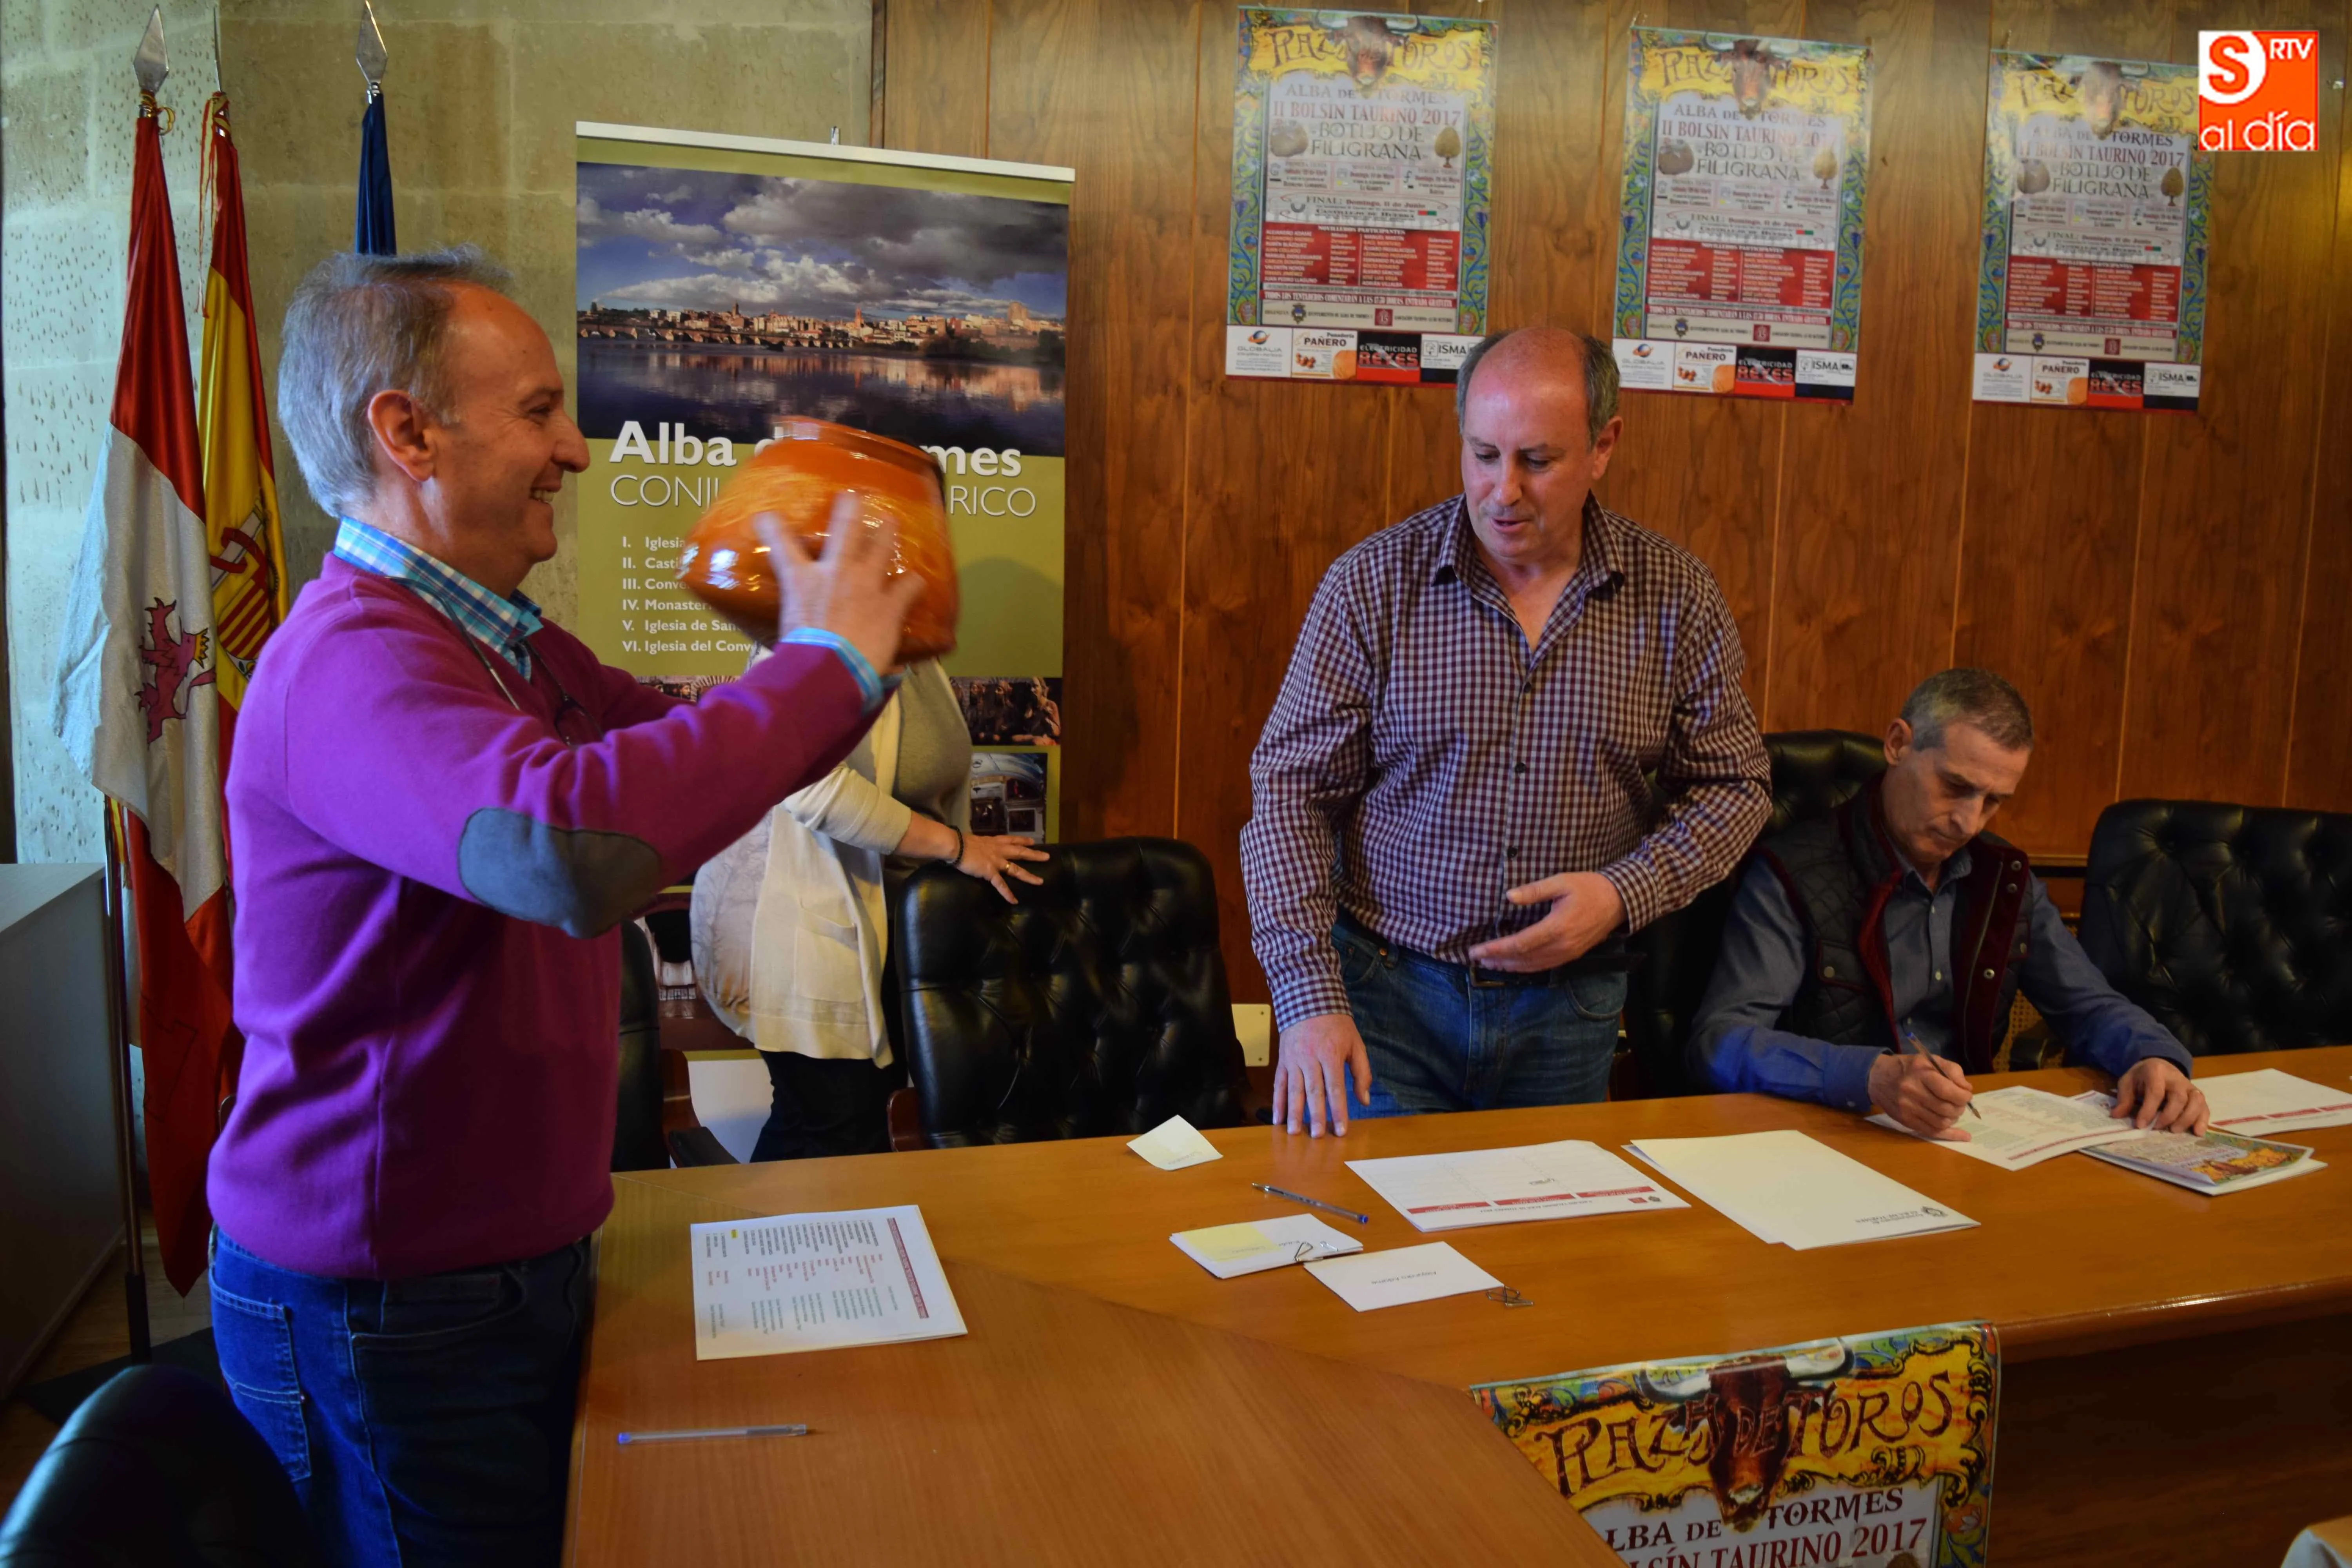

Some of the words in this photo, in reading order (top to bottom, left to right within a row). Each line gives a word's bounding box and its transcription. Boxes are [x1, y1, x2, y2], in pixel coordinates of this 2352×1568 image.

[1285, 83, 1331, 98] ALBA
[1338, 88, 1356, 99] DE
[1377, 88, 1447, 106] TORMES
[1274, 100, 1285, 117] II
[1350, 104, 1417, 125] TAURINO
[1422, 107, 1461, 130] 2017
[1674, 103, 1717, 118] ALBA
[1723, 110, 1739, 120] DE
[1760, 111, 1826, 129] TORES
[1399, 126, 1425, 142] DE
[1662, 120, 1672, 136] II
[1678, 120, 1730, 140] BOLSÍN
[2112, 131, 2173, 147] TORMES
[1311, 138, 1422, 160] FILIGRANA
[2088, 145, 2145, 165] TAURINO
[2151, 150, 2185, 168] 2017
[1697, 158, 1800, 181] FILIGRANA
[2130, 166, 2152, 182] DE
[2053, 178, 2149, 199] FILIGRANA
[1304, 336, 1347, 347] PAÑERO
[1439, 345, 1467, 355] ISMA
[1359, 351, 1419, 367] REYES
[1813, 360, 1839, 371] ISMA
[2160, 372, 2184, 382] ISMA
[609, 420, 737, 467] Alba
[919, 445, 1022, 477] mes
[622, 536, 632, 548] I.
[645, 536, 686, 551] Iglesia
[622, 557, 636, 569] II.
[645, 557, 679, 569] Casti
[622, 578, 641, 590] III.
[622, 599, 640, 611] IV.
[622, 620, 635, 632] V.
[645, 619, 687, 634] Iglesia
[690, 619, 708, 631] de
[622, 640, 641, 652] VI.
[645, 640, 687, 655] Iglesia
[690, 640, 711, 652] del
[715, 641, 755, 652] Conv
[1534, 1390, 1723, 1499] PLAZA
[1733, 1405, 1780, 1458] DE
[1782, 1370, 1953, 1464] TOROS
[1605, 1521, 1676, 1552] LBA
[1685, 1519, 1723, 1543] DE
[1768, 1487, 1904, 1530] TORMES
[1711, 1530, 1841, 1568] TAURINO
[1851, 1518, 1927, 1559] 2017
